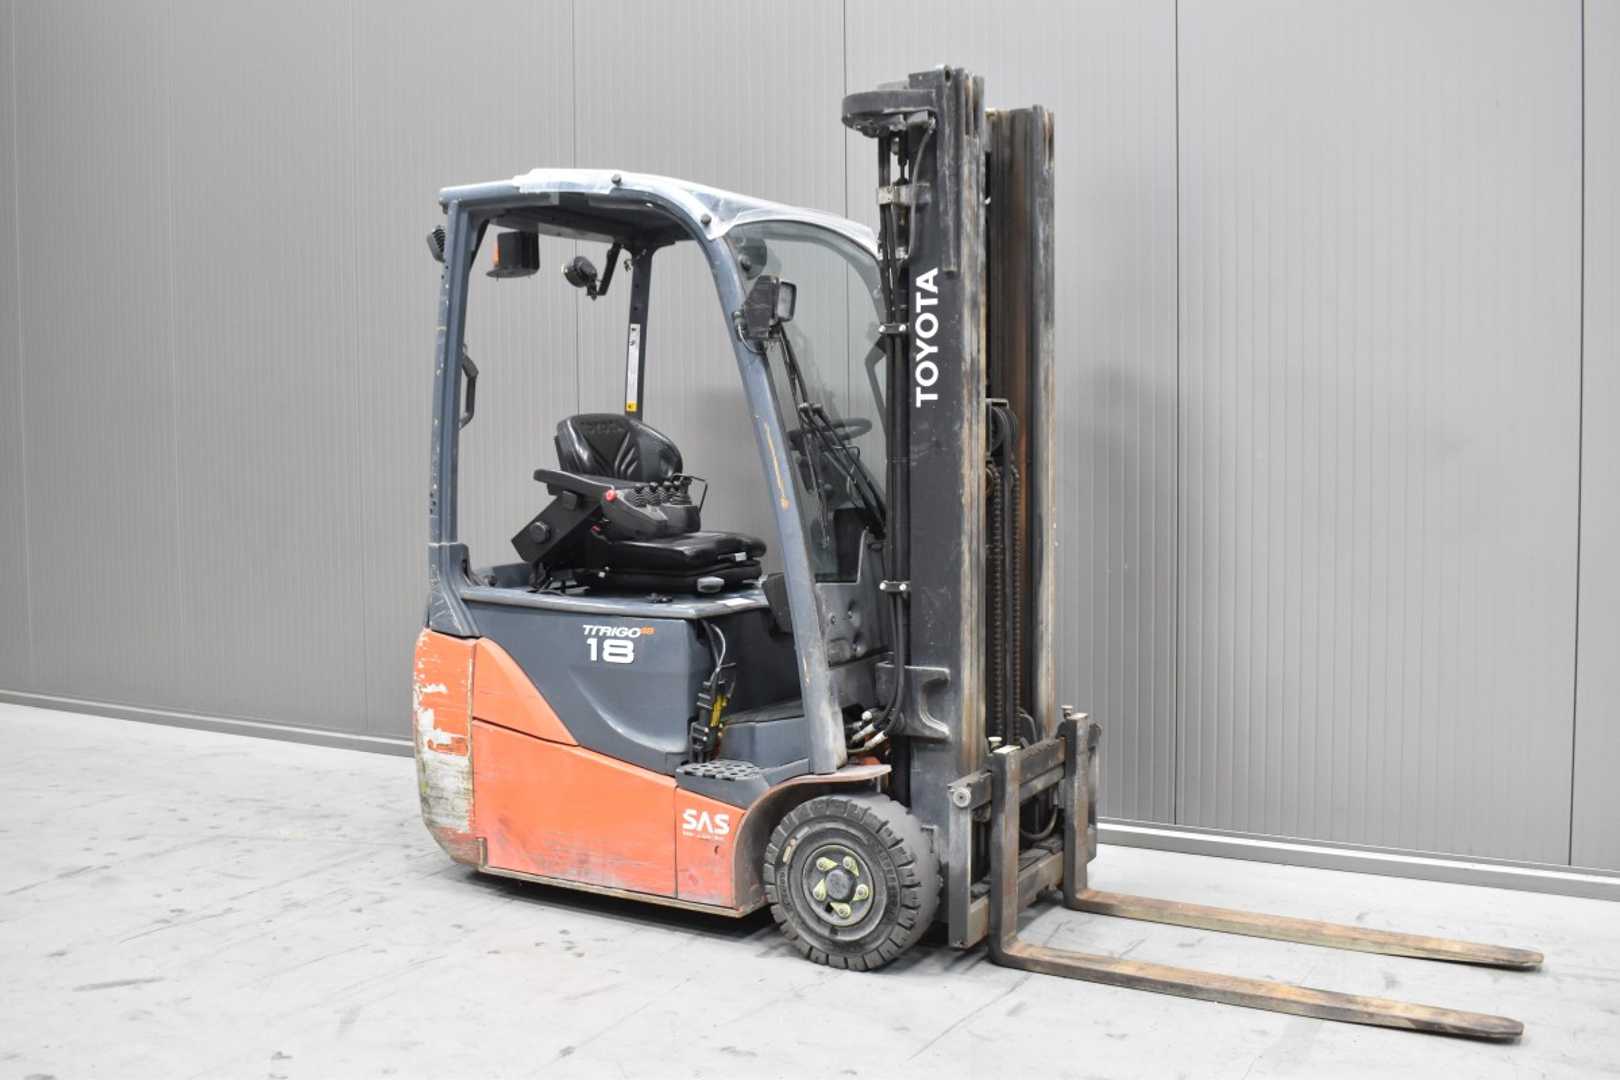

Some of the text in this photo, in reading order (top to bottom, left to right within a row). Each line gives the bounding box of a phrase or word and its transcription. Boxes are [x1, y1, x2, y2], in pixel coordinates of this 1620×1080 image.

[915, 267, 939, 408] TOYOTA
[586, 637, 634, 664] 18
[682, 809, 729, 834] SAS
